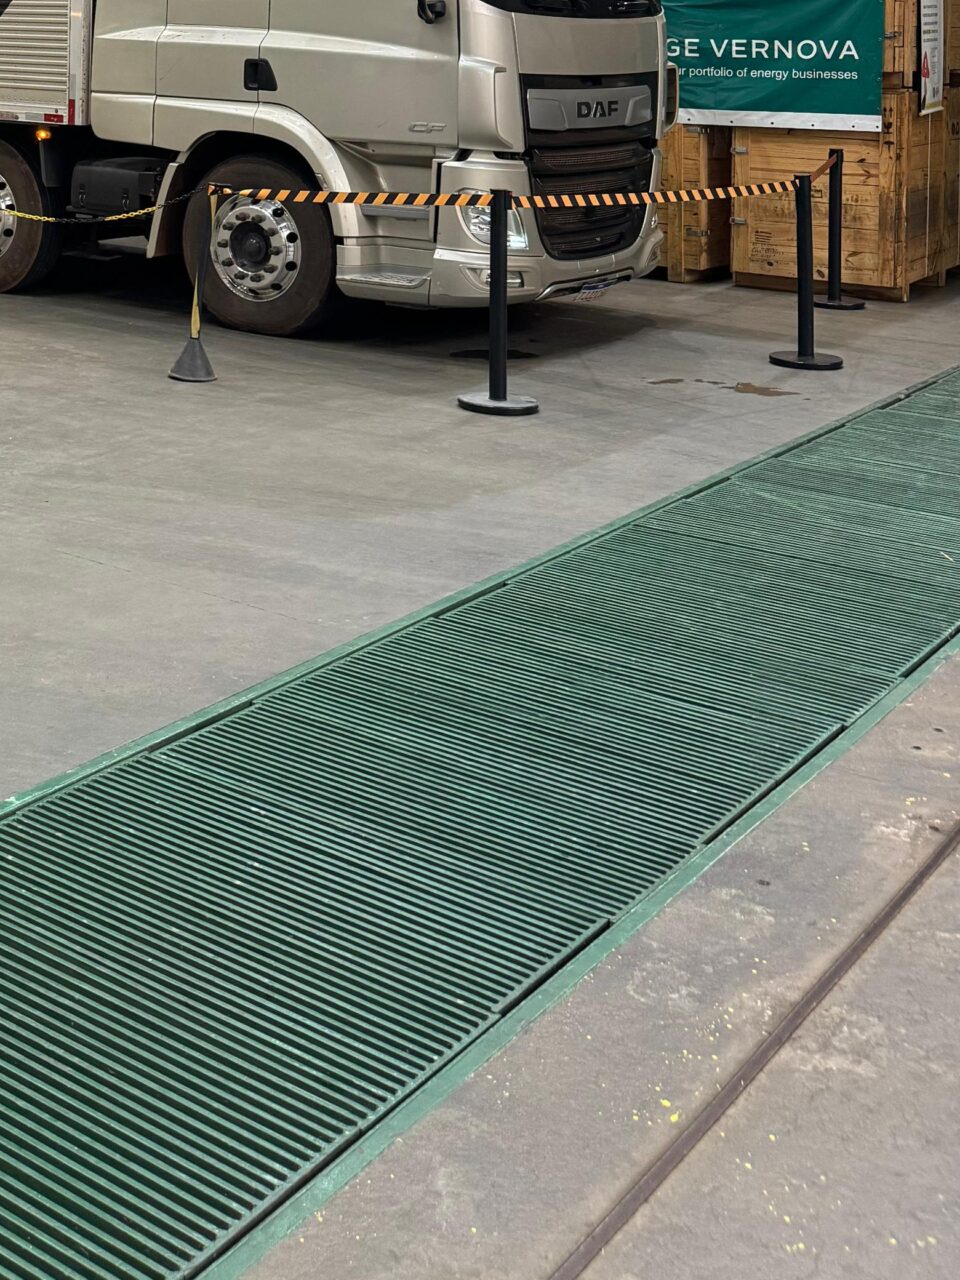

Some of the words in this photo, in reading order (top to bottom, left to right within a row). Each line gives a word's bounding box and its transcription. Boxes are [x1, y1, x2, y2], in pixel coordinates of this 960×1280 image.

[665, 38, 700, 57] GE
[709, 38, 859, 60] VERNOVA
[689, 66, 734, 78] portfolio
[736, 67, 749, 77] of
[750, 68, 789, 80] energy
[792, 68, 859, 80] businesses
[576, 100, 619, 118] DAF
[408, 121, 447, 134] CF
